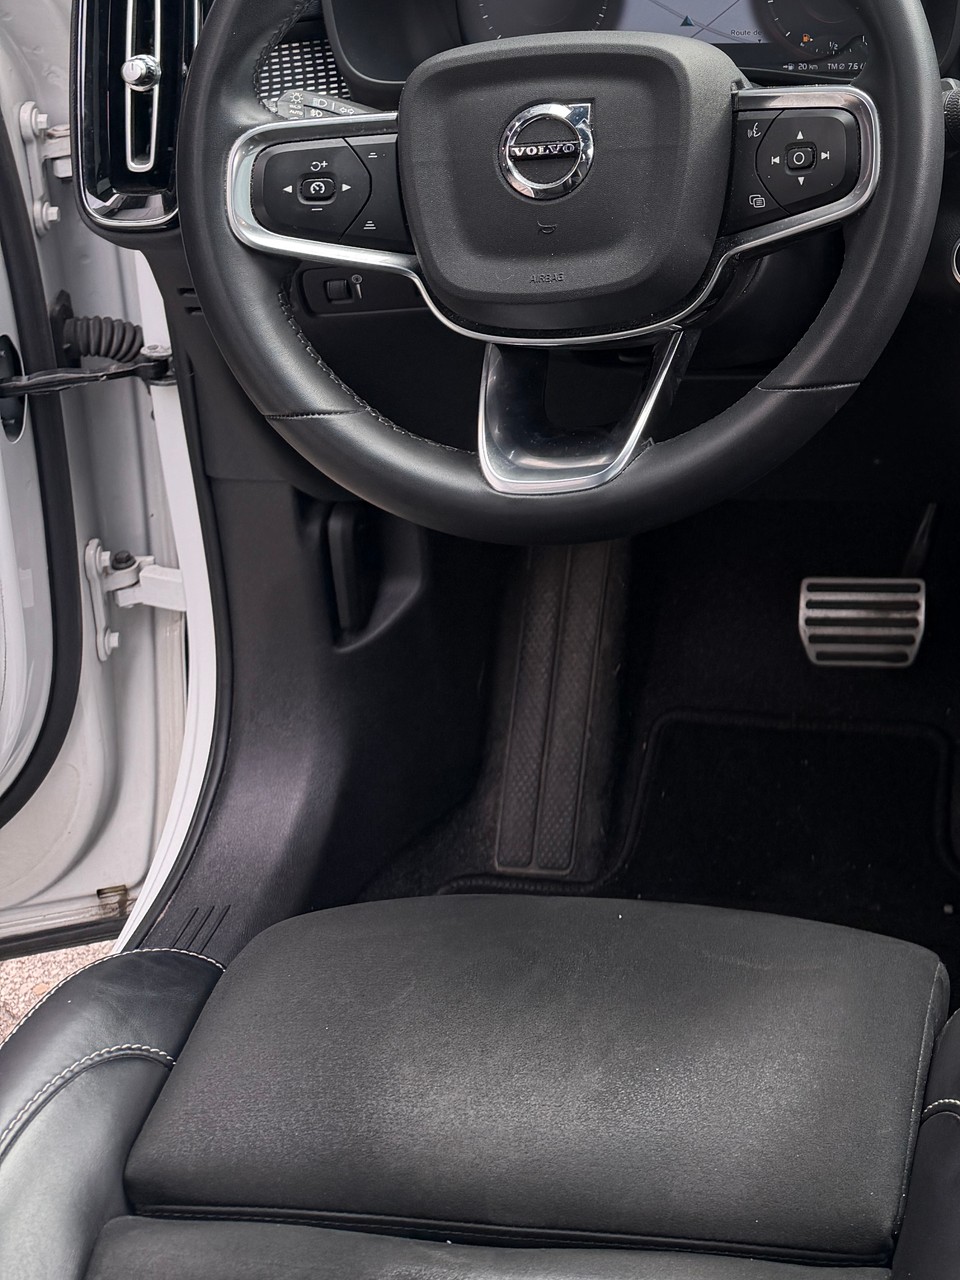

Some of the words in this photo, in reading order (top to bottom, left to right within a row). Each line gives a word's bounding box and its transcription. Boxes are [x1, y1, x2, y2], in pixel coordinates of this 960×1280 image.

[798, 62, 808, 71] 20
[512, 143, 576, 157] VOLVO
[530, 272, 564, 284] AIRBAG
